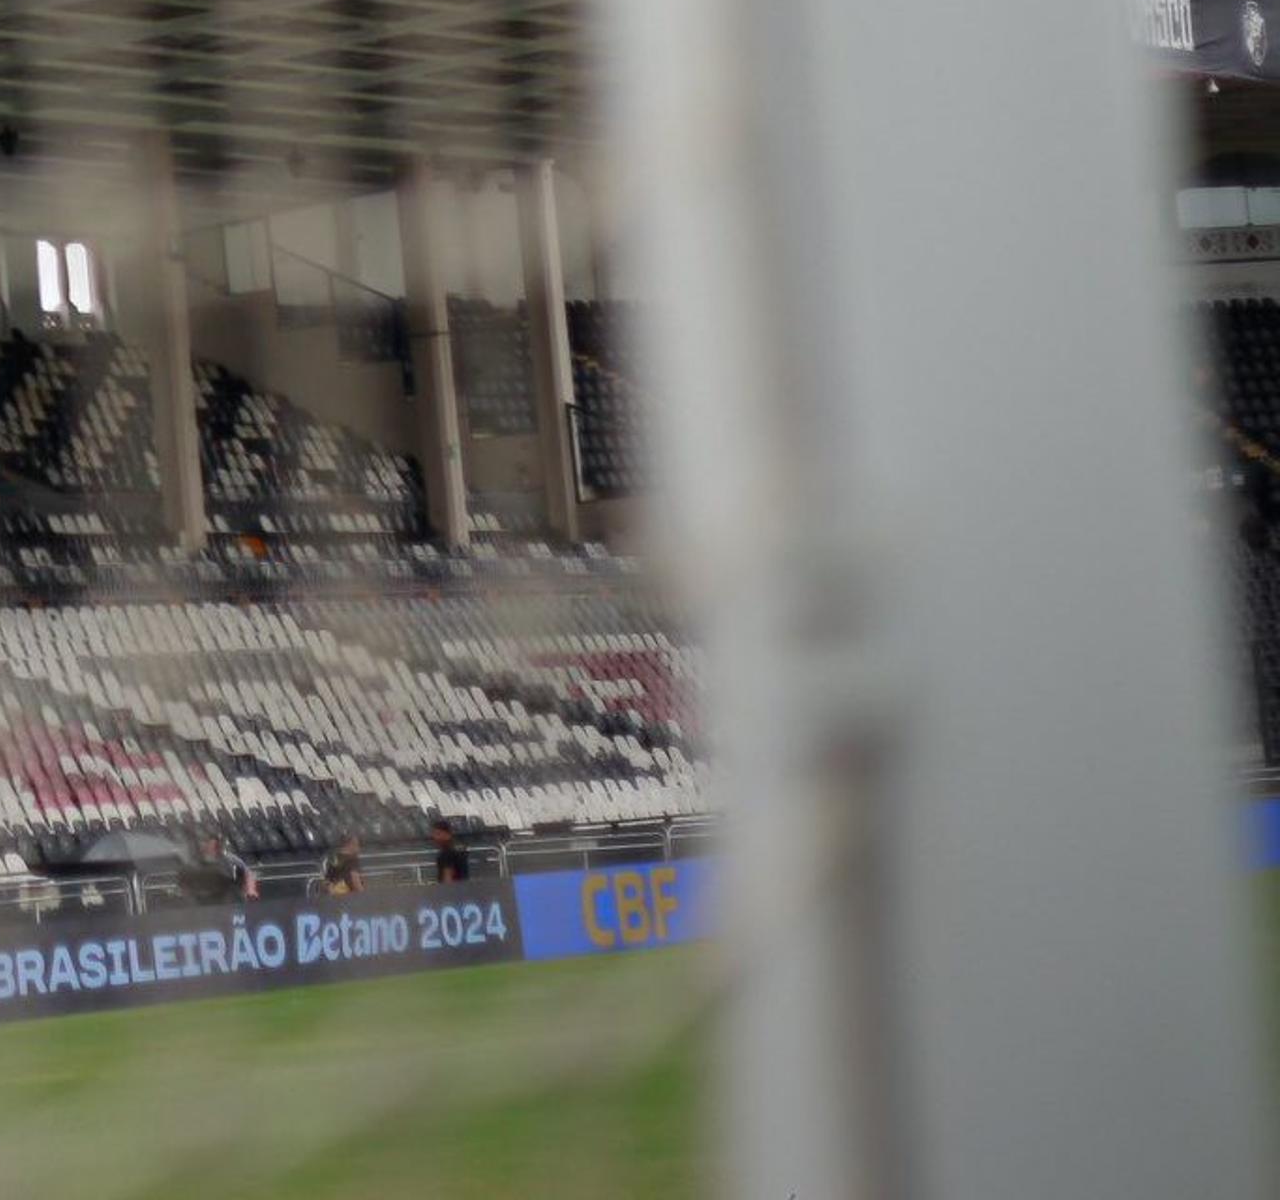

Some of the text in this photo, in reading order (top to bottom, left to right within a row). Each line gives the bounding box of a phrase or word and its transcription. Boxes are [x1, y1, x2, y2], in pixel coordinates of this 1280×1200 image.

[296, 912, 409, 964] Betano
[417, 901, 508, 950] 2024
[582, 866, 679, 948] CBF
